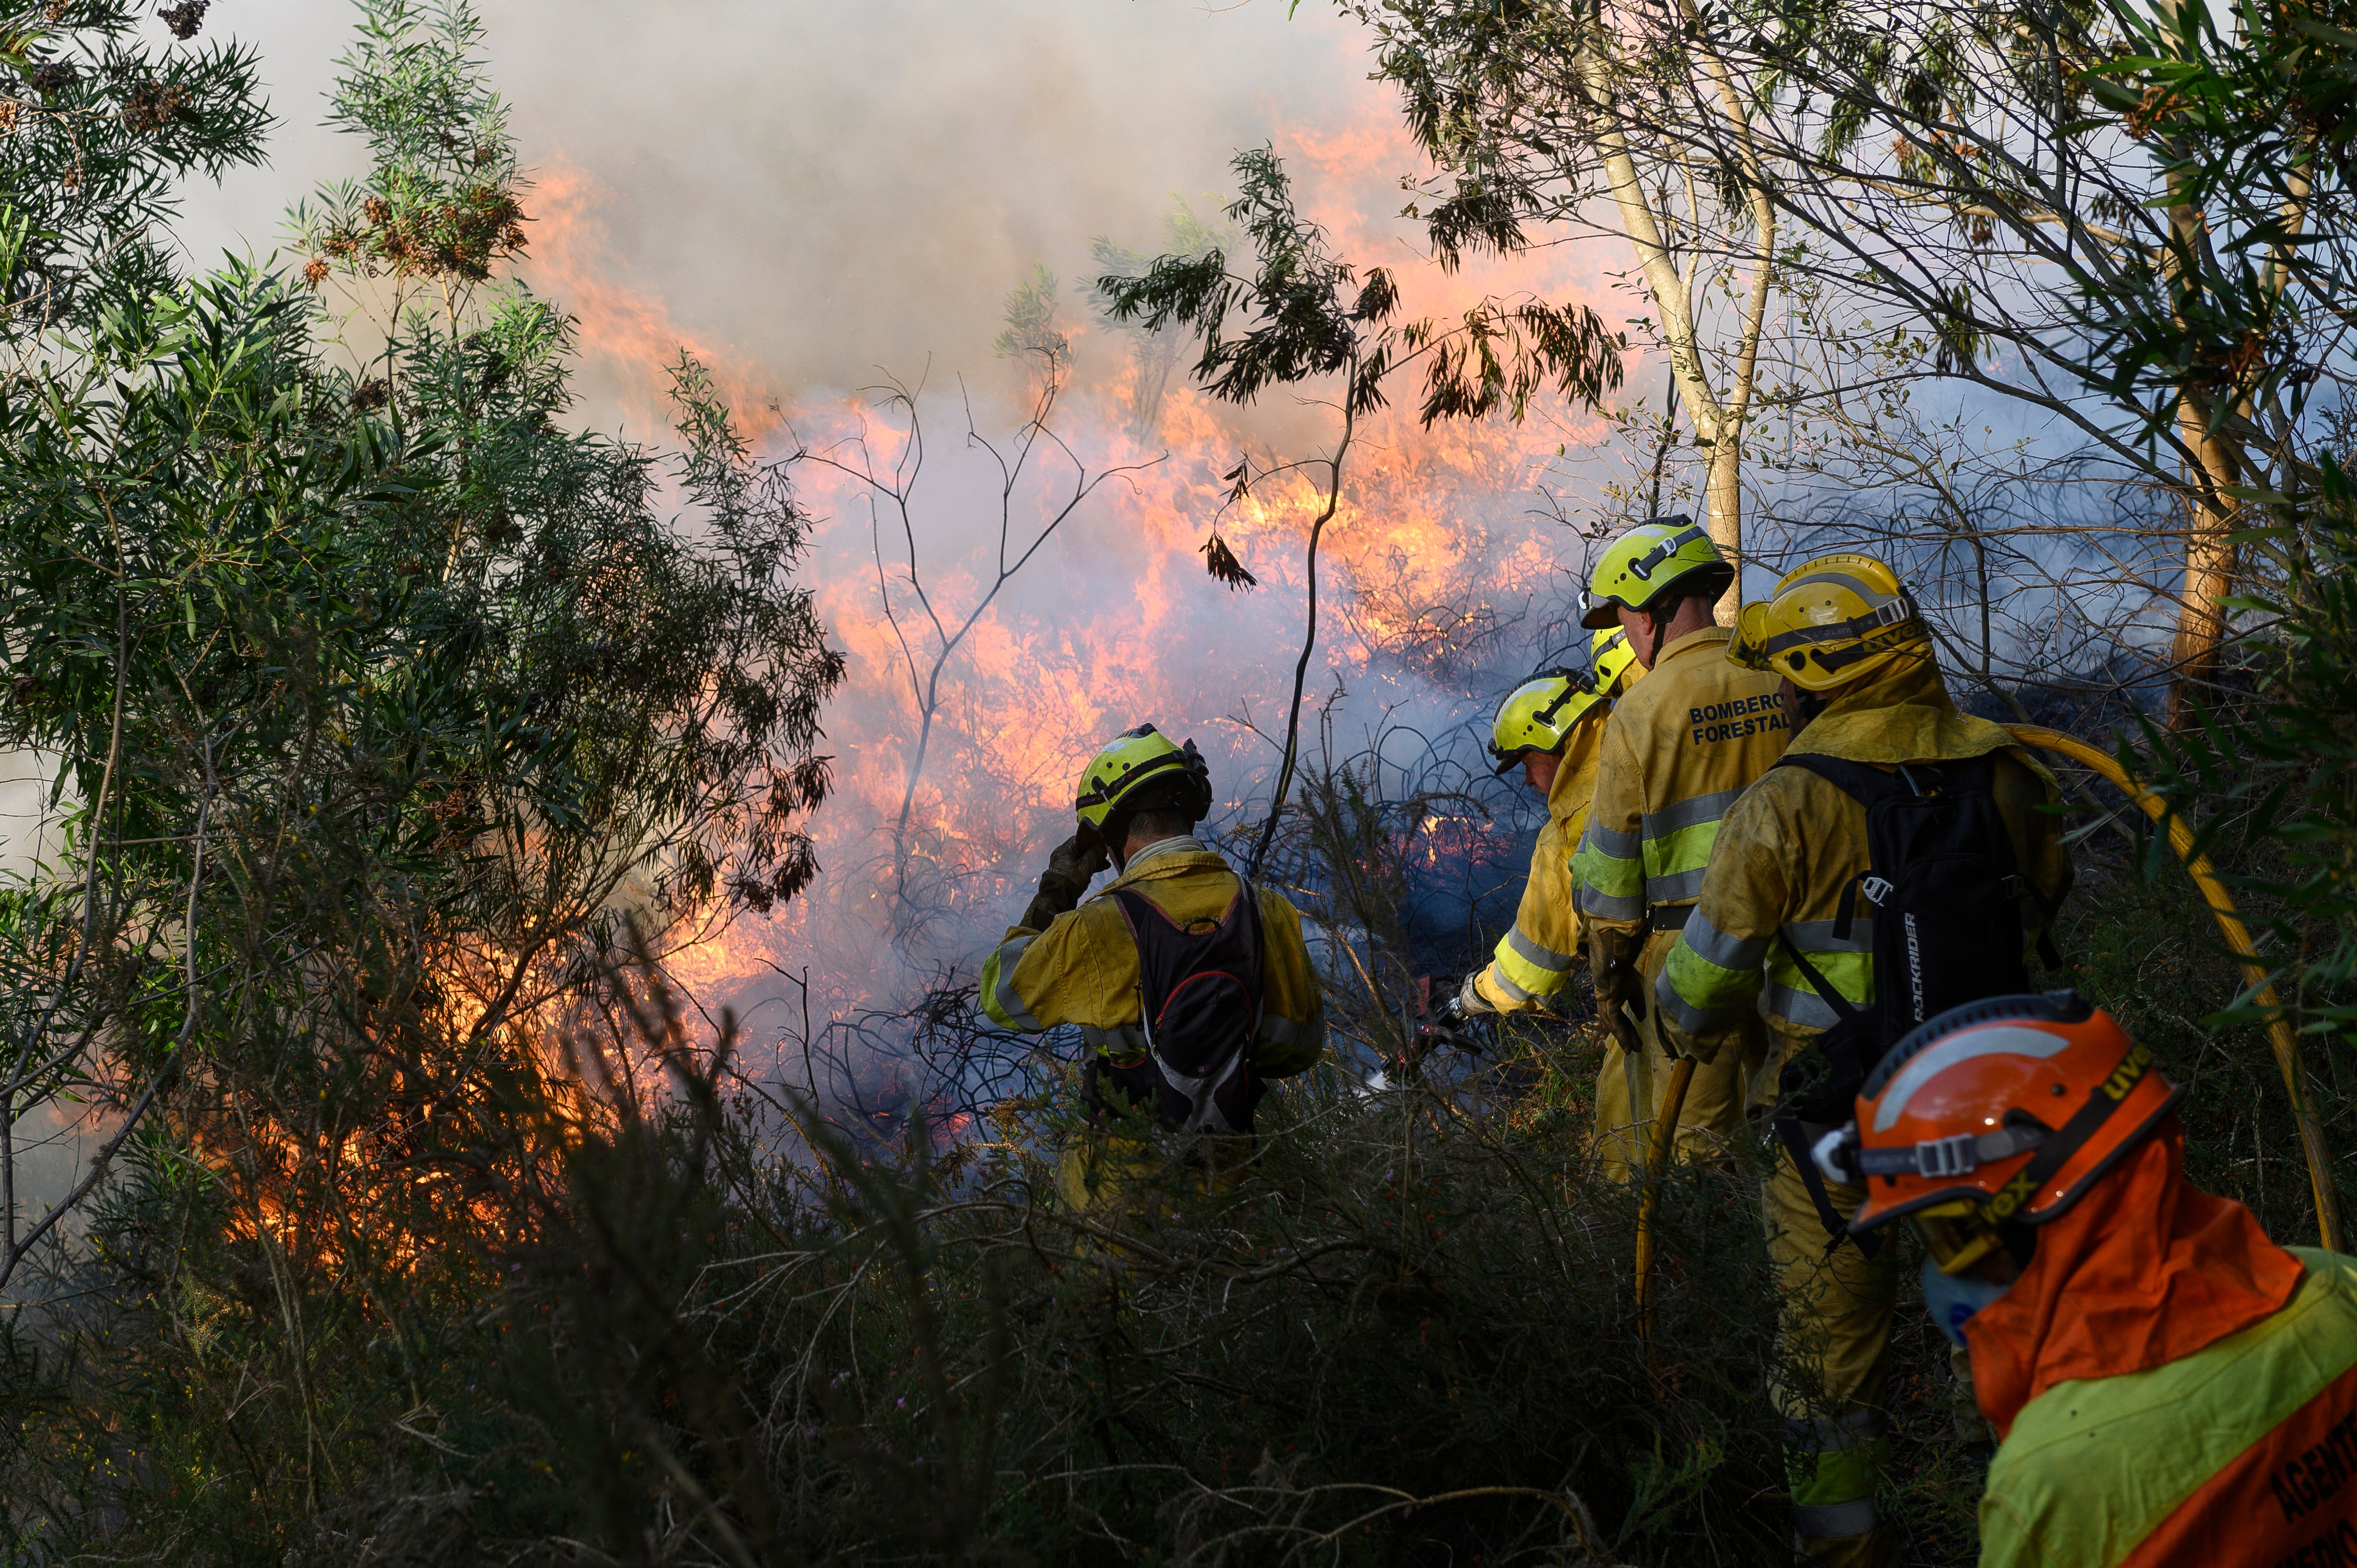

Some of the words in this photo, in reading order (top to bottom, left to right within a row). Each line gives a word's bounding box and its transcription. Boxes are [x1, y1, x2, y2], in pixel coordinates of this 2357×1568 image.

[1831, 622, 1863, 635] LENSR
[1862, 622, 1925, 652] uvex
[1689, 692, 1786, 724] BOMBERO
[1692, 712, 1790, 746] FORESTAL
[1904, 912, 1924, 1023] ROCKRIDER
